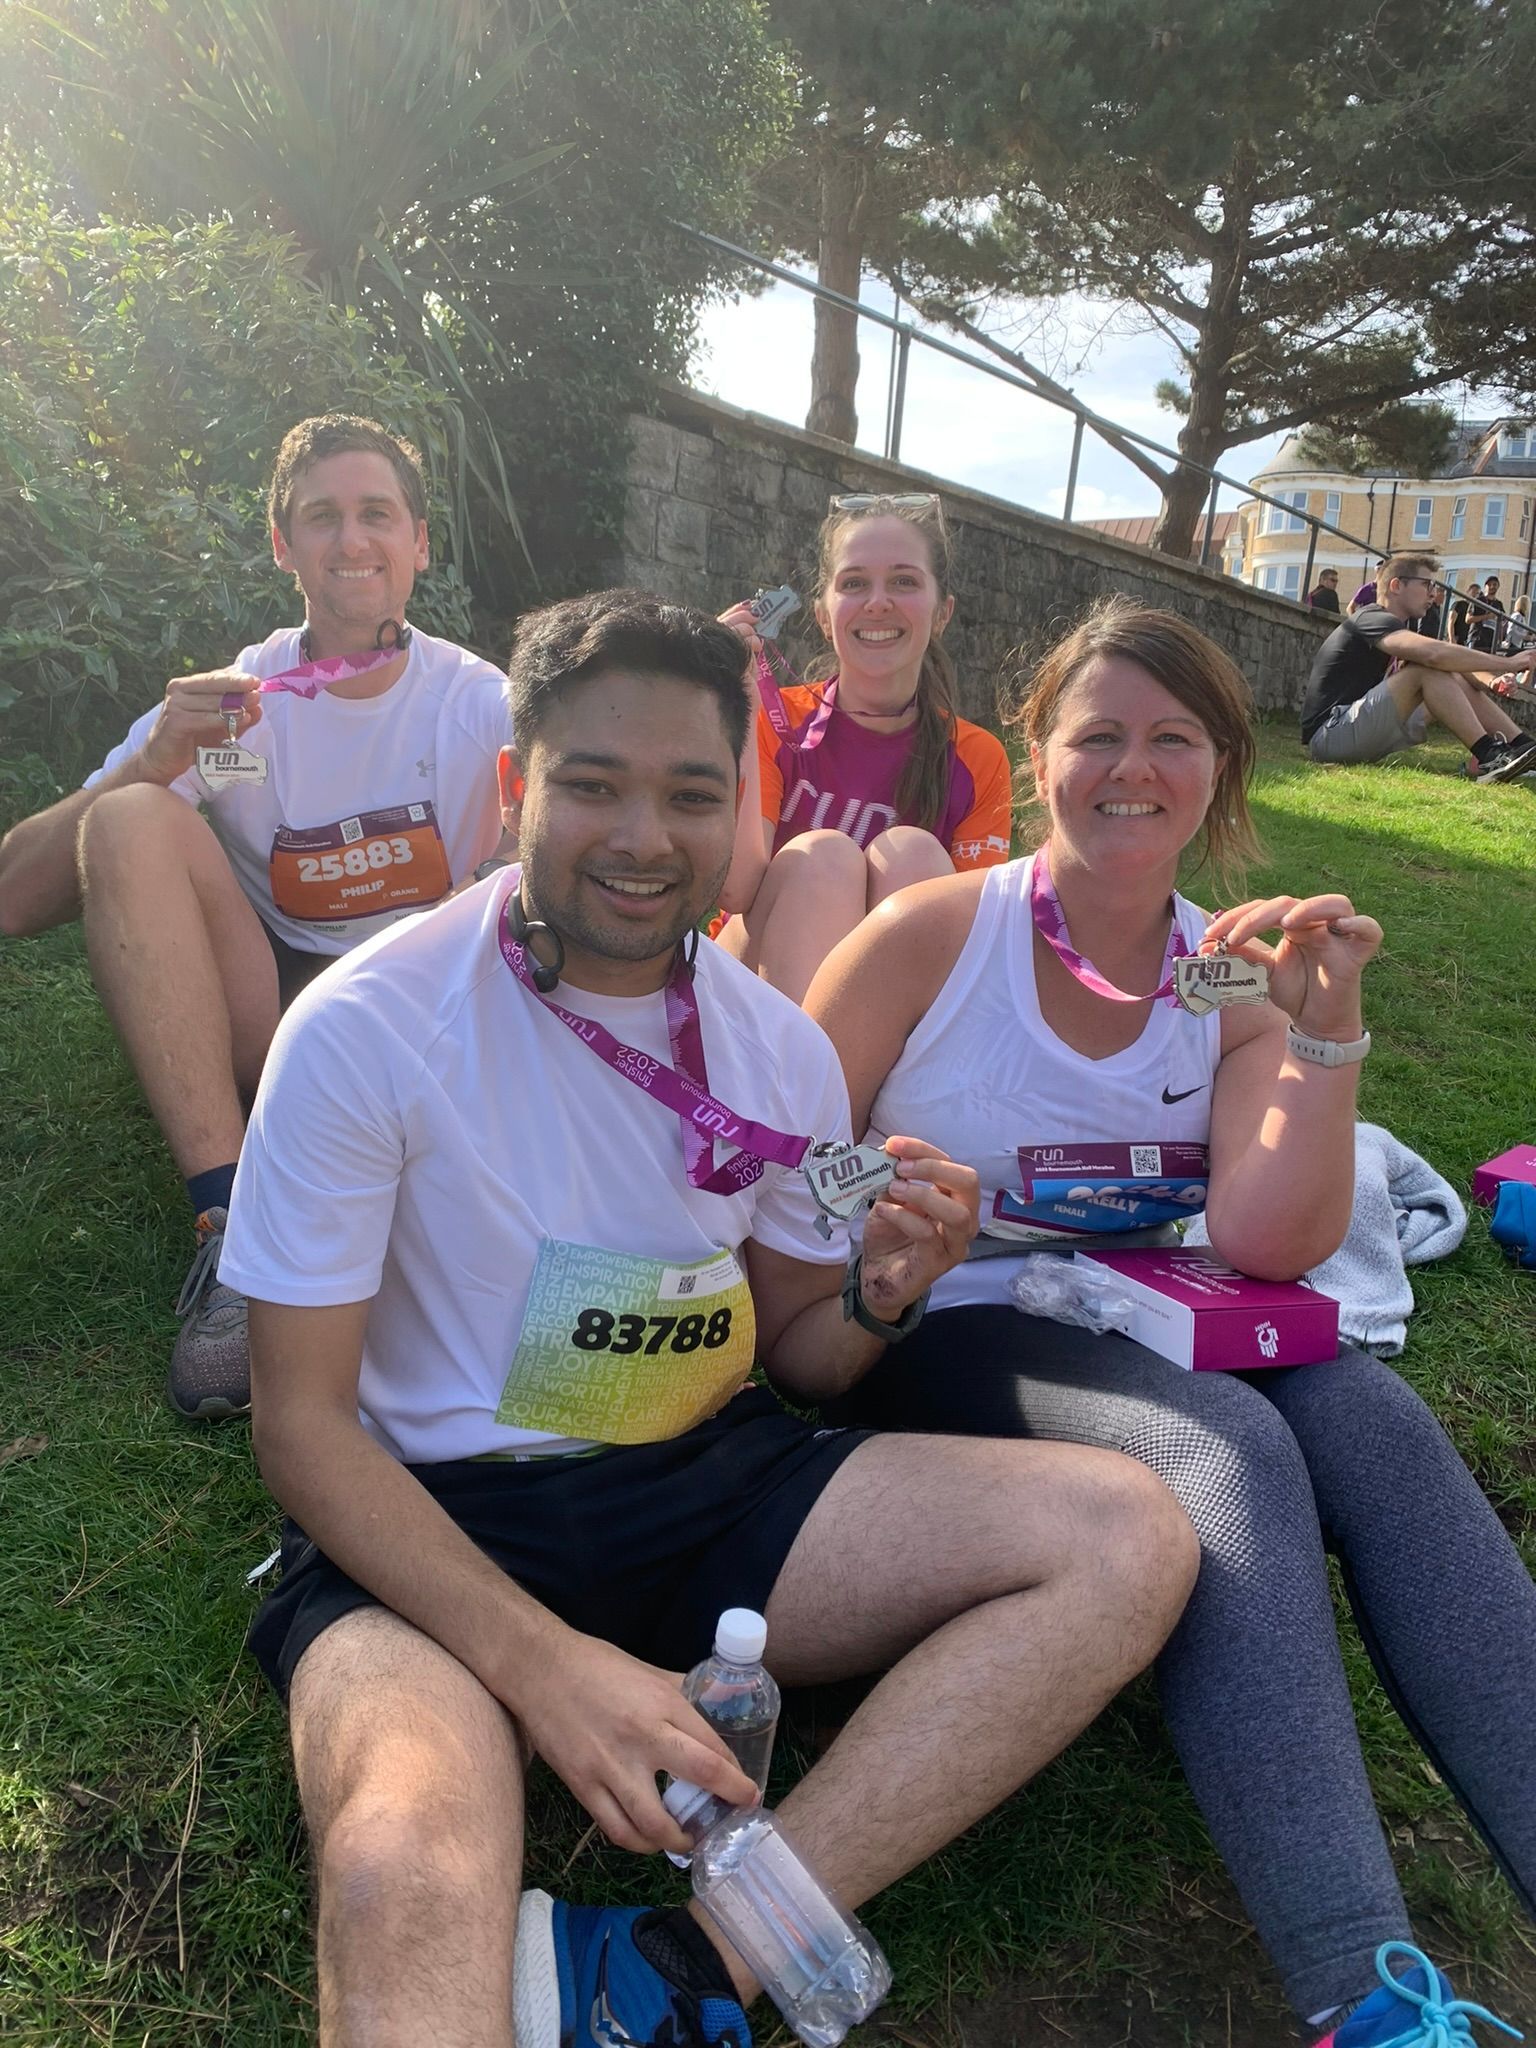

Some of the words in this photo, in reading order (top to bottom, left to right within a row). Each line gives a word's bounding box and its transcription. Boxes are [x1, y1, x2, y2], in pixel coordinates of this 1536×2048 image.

[769, 709, 787, 733] run
[204, 752, 240, 765] run
[778, 779, 897, 846] run
[297, 838, 413, 882] 25883
[341, 880, 385, 898] PHILIP
[390, 888, 419, 898] ORANGE
[329, 902, 348, 910] MALE
[559, 1011, 597, 1042] run
[613, 1059, 653, 1088] finisher
[616, 1046, 660, 1076] 2022
[680, 1080, 731, 1118] bournemouth
[692, 1103, 740, 1138] run
[726, 1153, 757, 1174] finishe
[1034, 1149, 1063, 1161] run
[819, 1155, 863, 1188] run
[838, 1162, 891, 1190] bournemouth
[1053, 1203, 1087, 1218] FEMALE
[570, 1247, 664, 1275] EMPOWERMENT
[565, 1261, 661, 1292] INSPIRATION
[561, 1279, 657, 1311] EMPATHY
[571, 1308, 732, 1355] 83788
[530, 1349, 551, 1391] ABILITY
[549, 1352, 597, 1373] JOY
[594, 1355, 608, 1383] HOPE
[602, 1357, 621, 1384] WIN
[503, 1387, 608, 1413] DETERMINATION
[544, 1378, 611, 1401] WORTH
[499, 1400, 604, 1431] COURAGE
[625, 1407, 665, 1423] CARE
